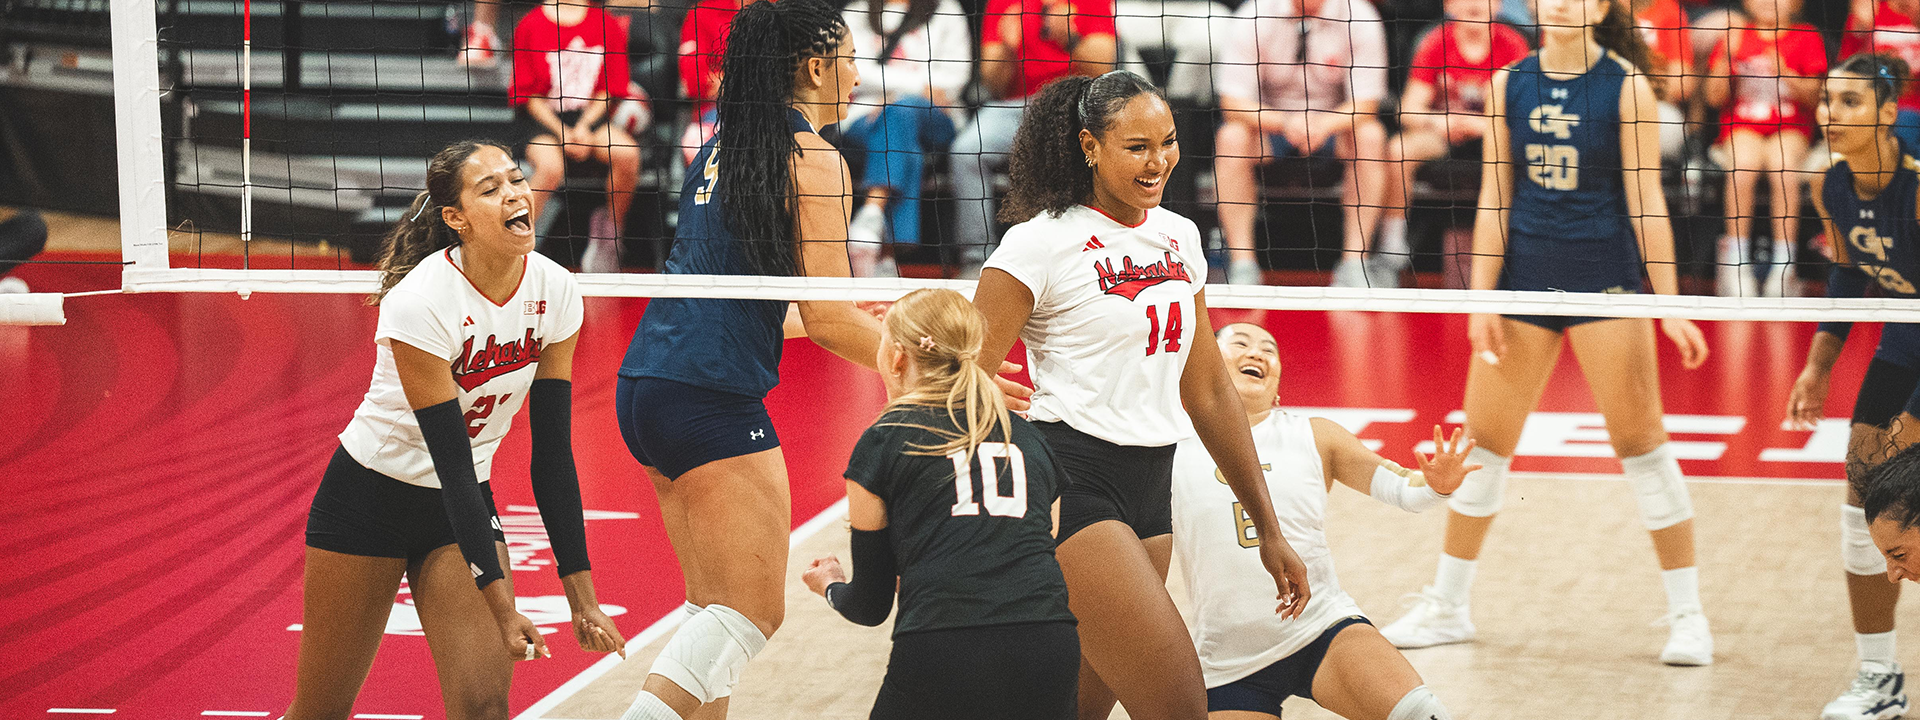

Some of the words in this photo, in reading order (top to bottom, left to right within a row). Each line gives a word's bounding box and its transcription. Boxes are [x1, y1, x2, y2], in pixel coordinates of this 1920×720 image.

[1525, 143, 1579, 191] 20
[1145, 301, 1183, 357] 14
[463, 393, 513, 439] 2
[945, 441, 1028, 519] 10
